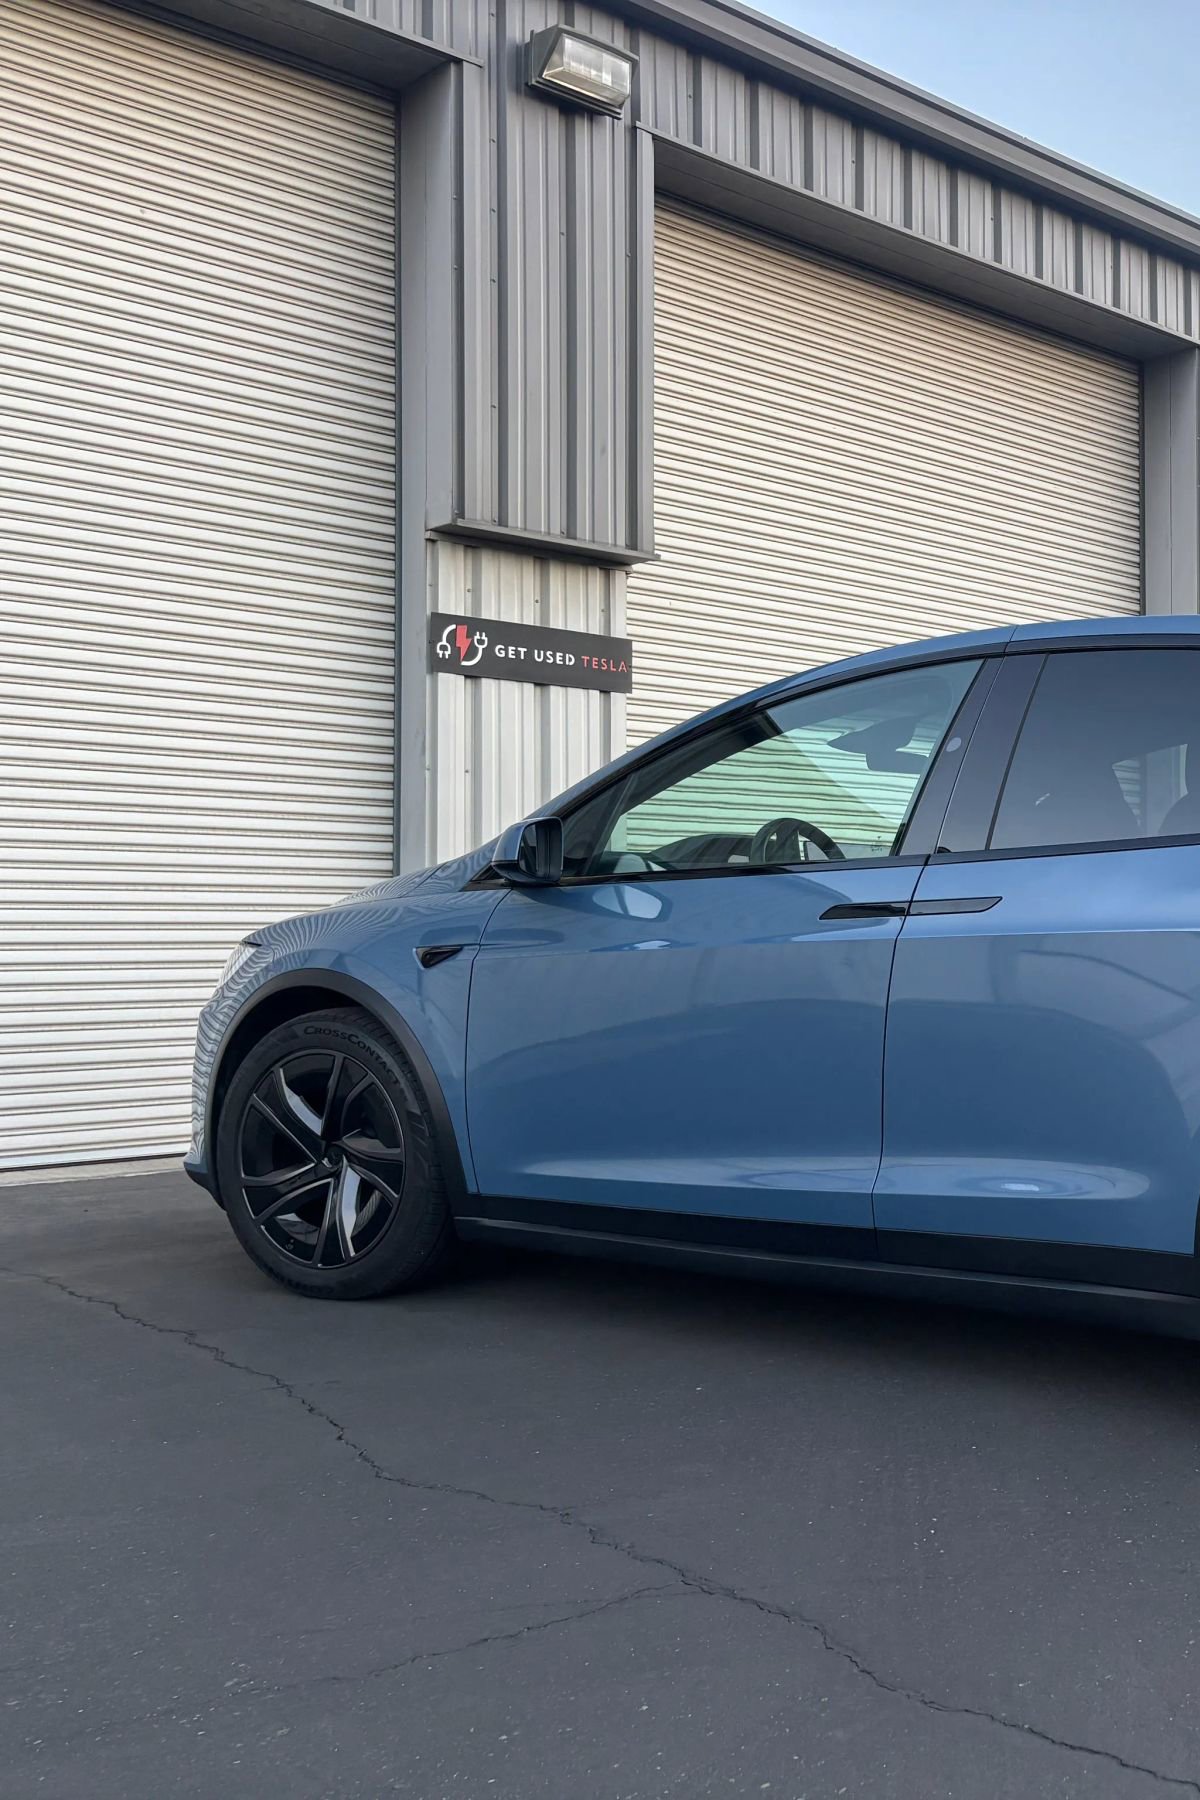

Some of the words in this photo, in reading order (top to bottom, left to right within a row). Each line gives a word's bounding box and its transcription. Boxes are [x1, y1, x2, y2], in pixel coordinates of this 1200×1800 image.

[495, 645, 527, 660] GET
[534, 649, 575, 666] USED
[581, 656, 627, 673] TESLA
